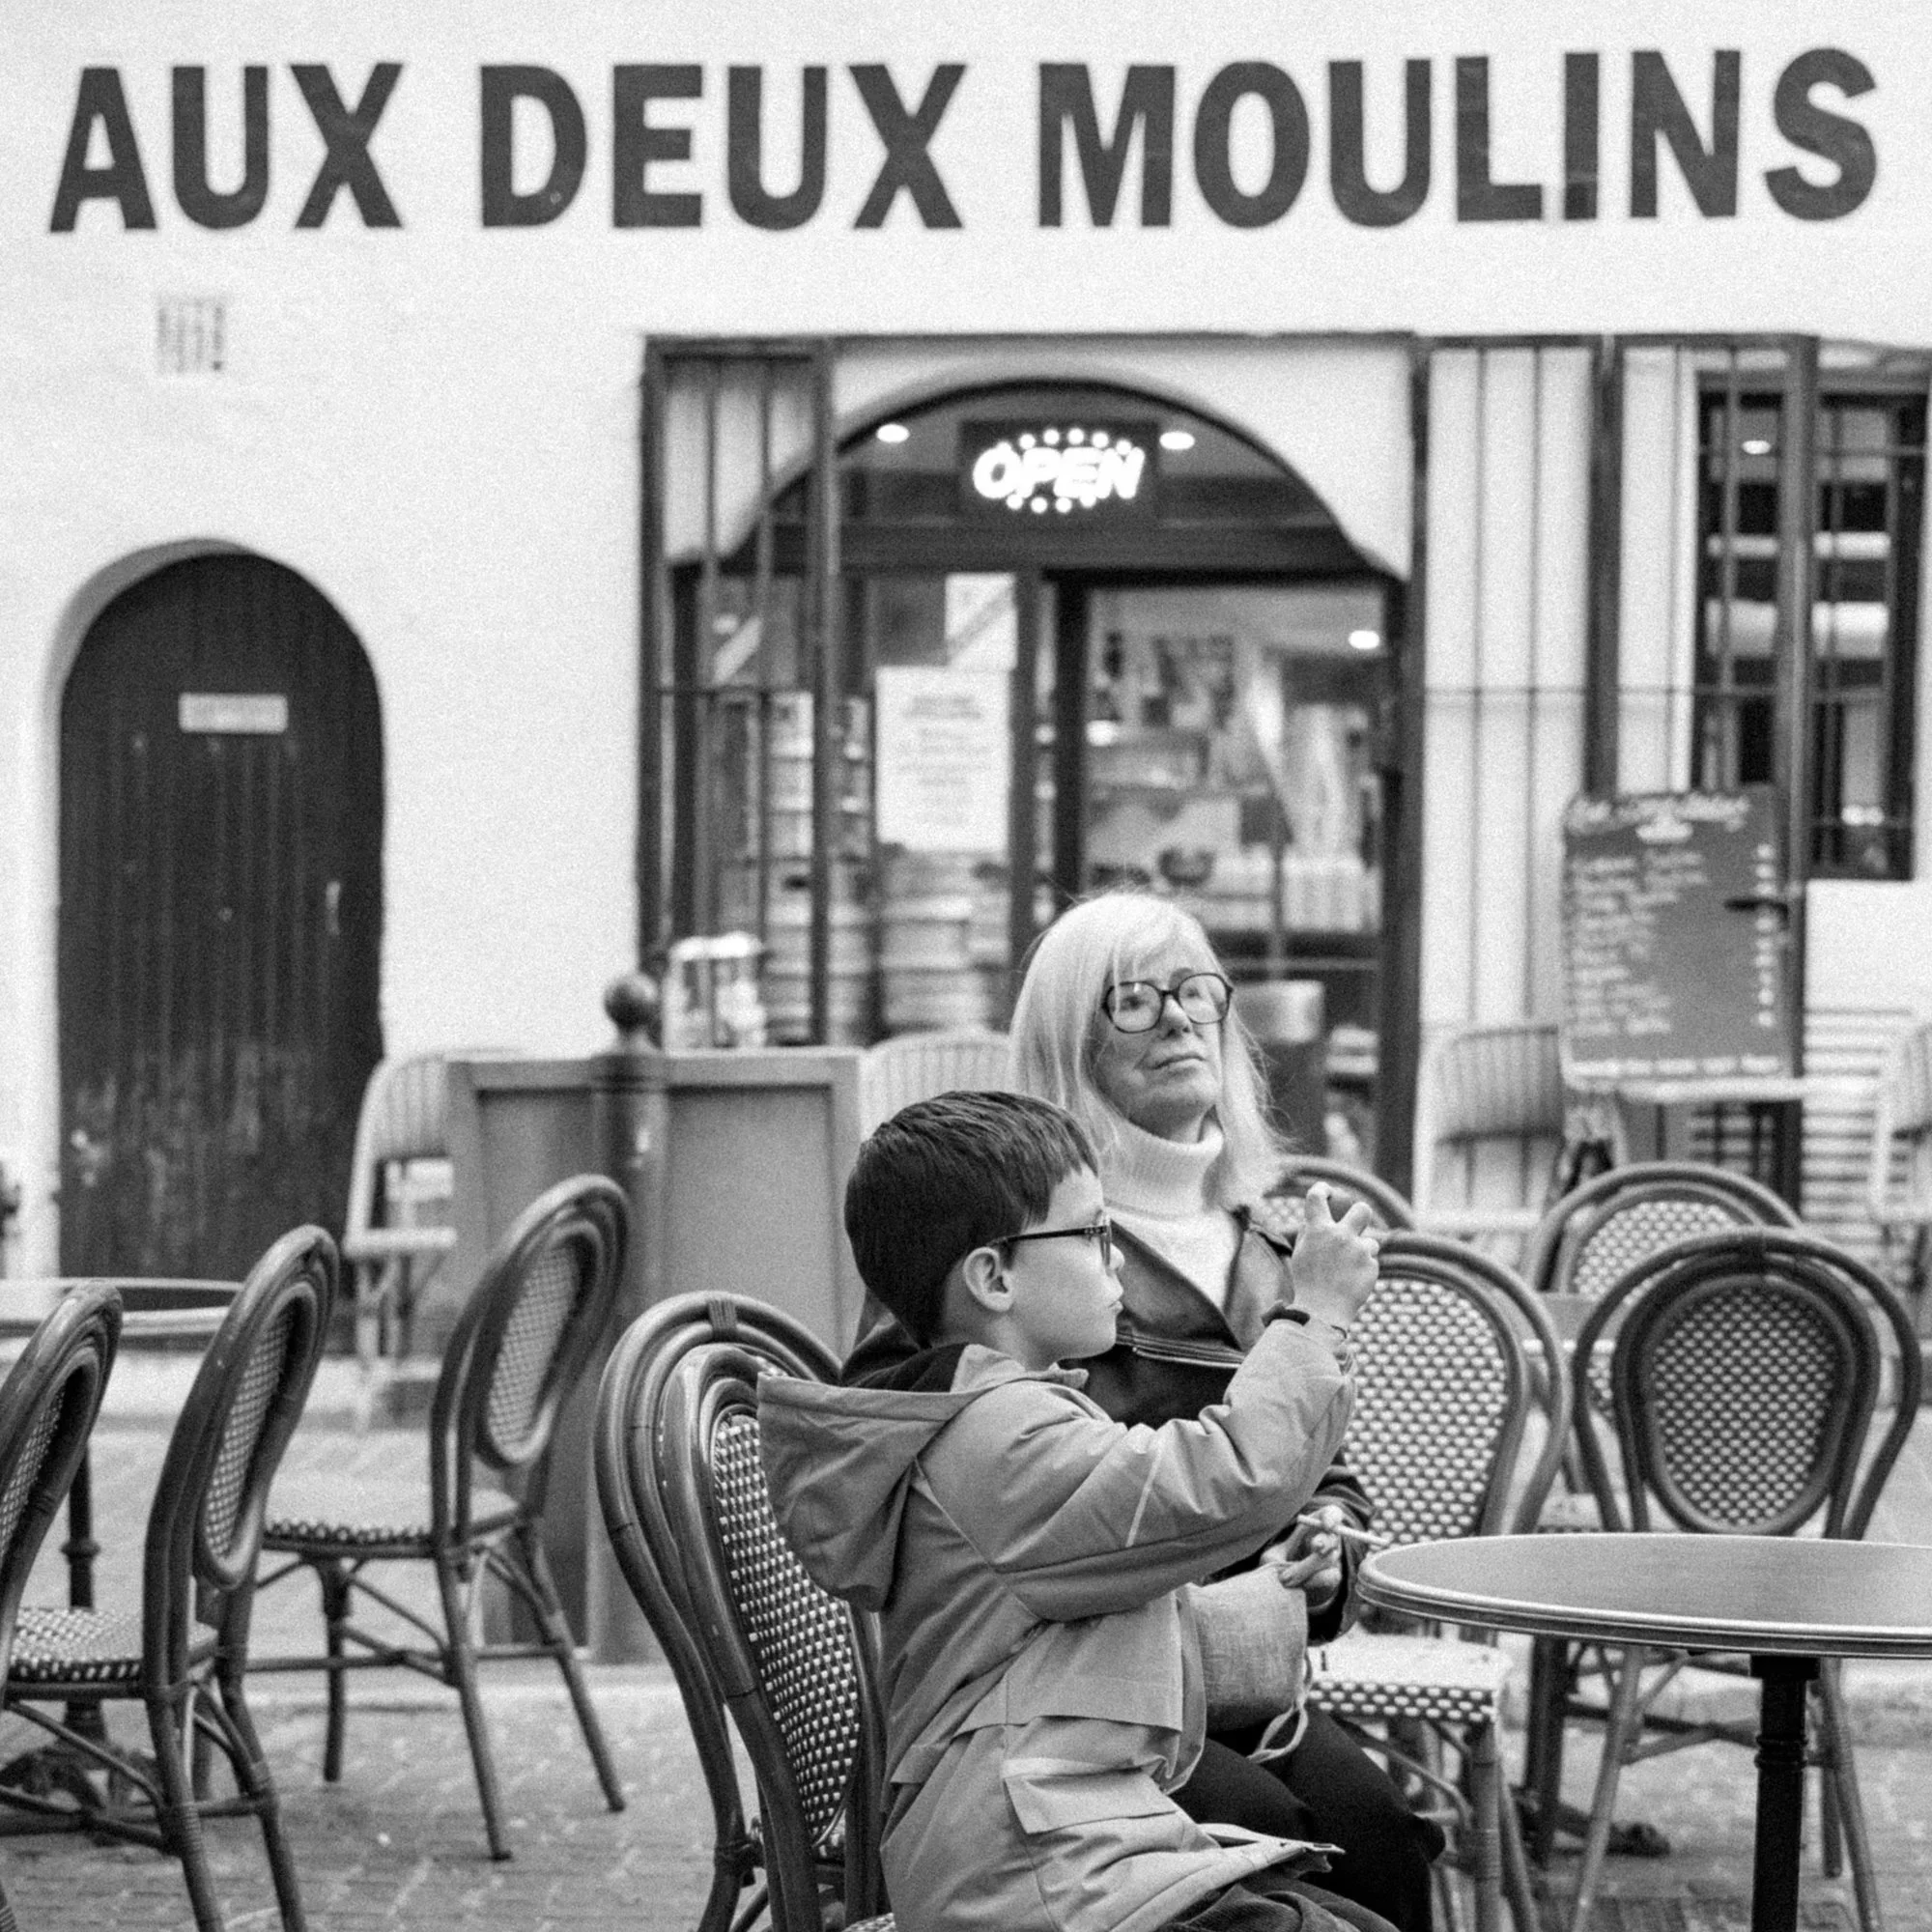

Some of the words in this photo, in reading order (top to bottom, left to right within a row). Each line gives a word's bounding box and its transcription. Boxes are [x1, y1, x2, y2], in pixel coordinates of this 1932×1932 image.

[49, 62, 403, 234] AUX
[479, 63, 967, 232] DEUX
[1037, 47, 1877, 230] MOULINS
[972, 445, 1146, 499] OPEN
